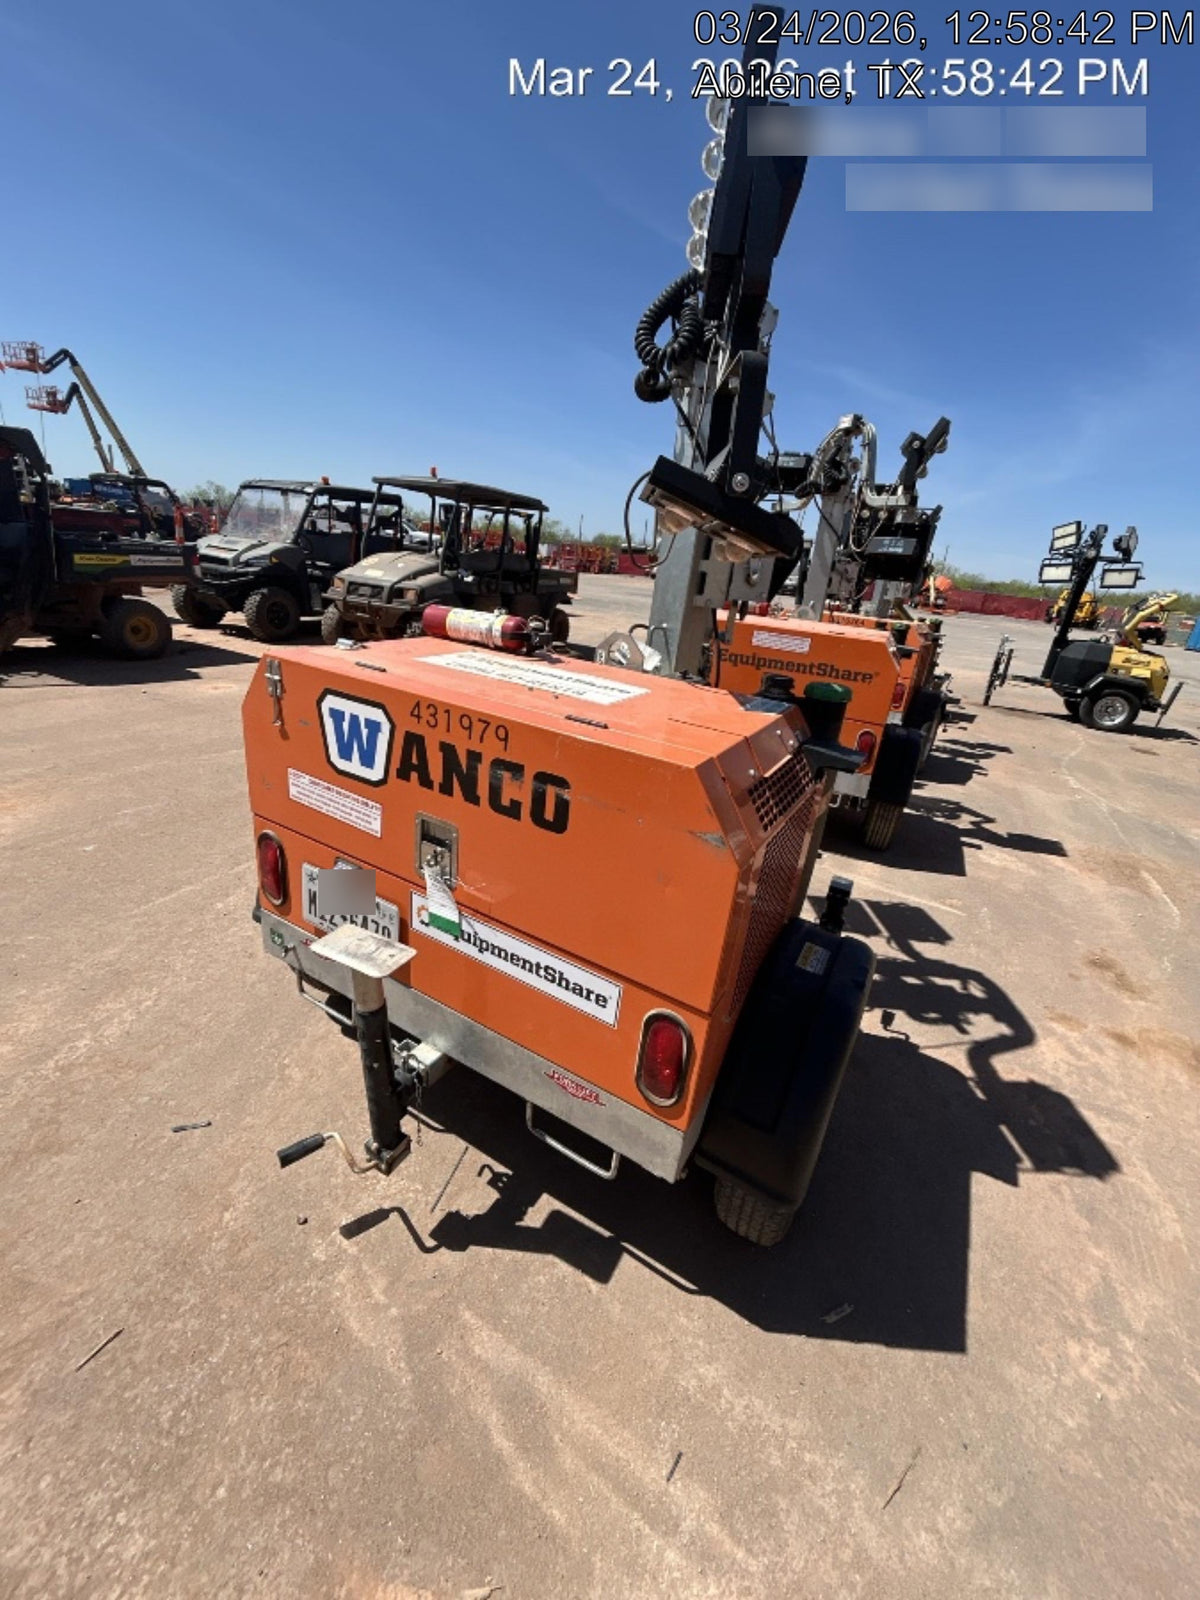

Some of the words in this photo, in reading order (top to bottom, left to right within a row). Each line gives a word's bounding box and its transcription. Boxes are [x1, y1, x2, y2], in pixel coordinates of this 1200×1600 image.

[718, 651, 874, 684] EquipmentShare
[408, 699, 511, 752] 431979
[328, 706, 572, 834] WANCO
[452, 928, 610, 1009] uipmentShare
